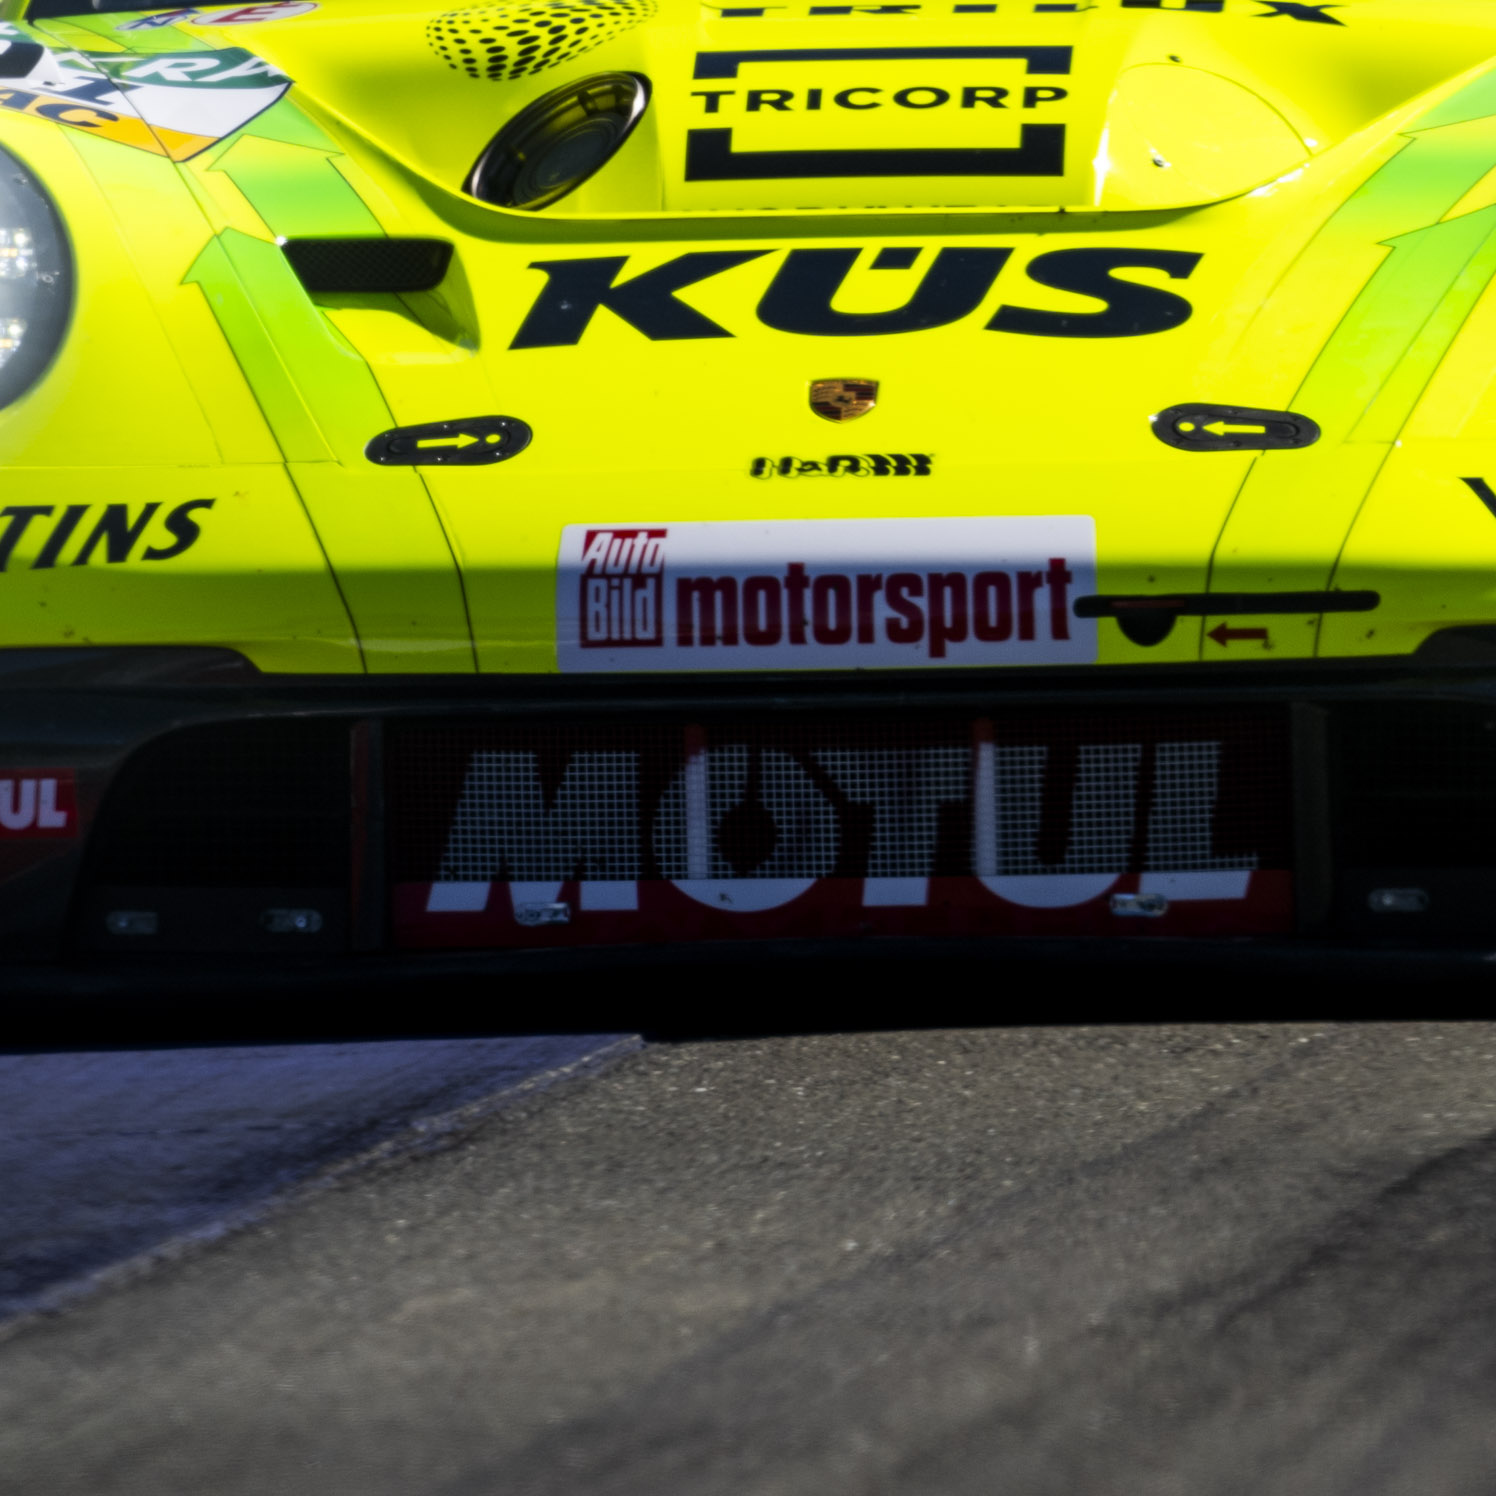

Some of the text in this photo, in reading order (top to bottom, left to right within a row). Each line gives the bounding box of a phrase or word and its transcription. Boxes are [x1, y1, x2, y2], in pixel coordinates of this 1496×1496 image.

[690, 84, 1069, 114] TRICORP
[507, 246, 1205, 350] KÜS
[581, 530, 666, 574] Auto
[587, 557, 1073, 658] Bild motorsport
[425, 740, 1260, 913] MOTUL
